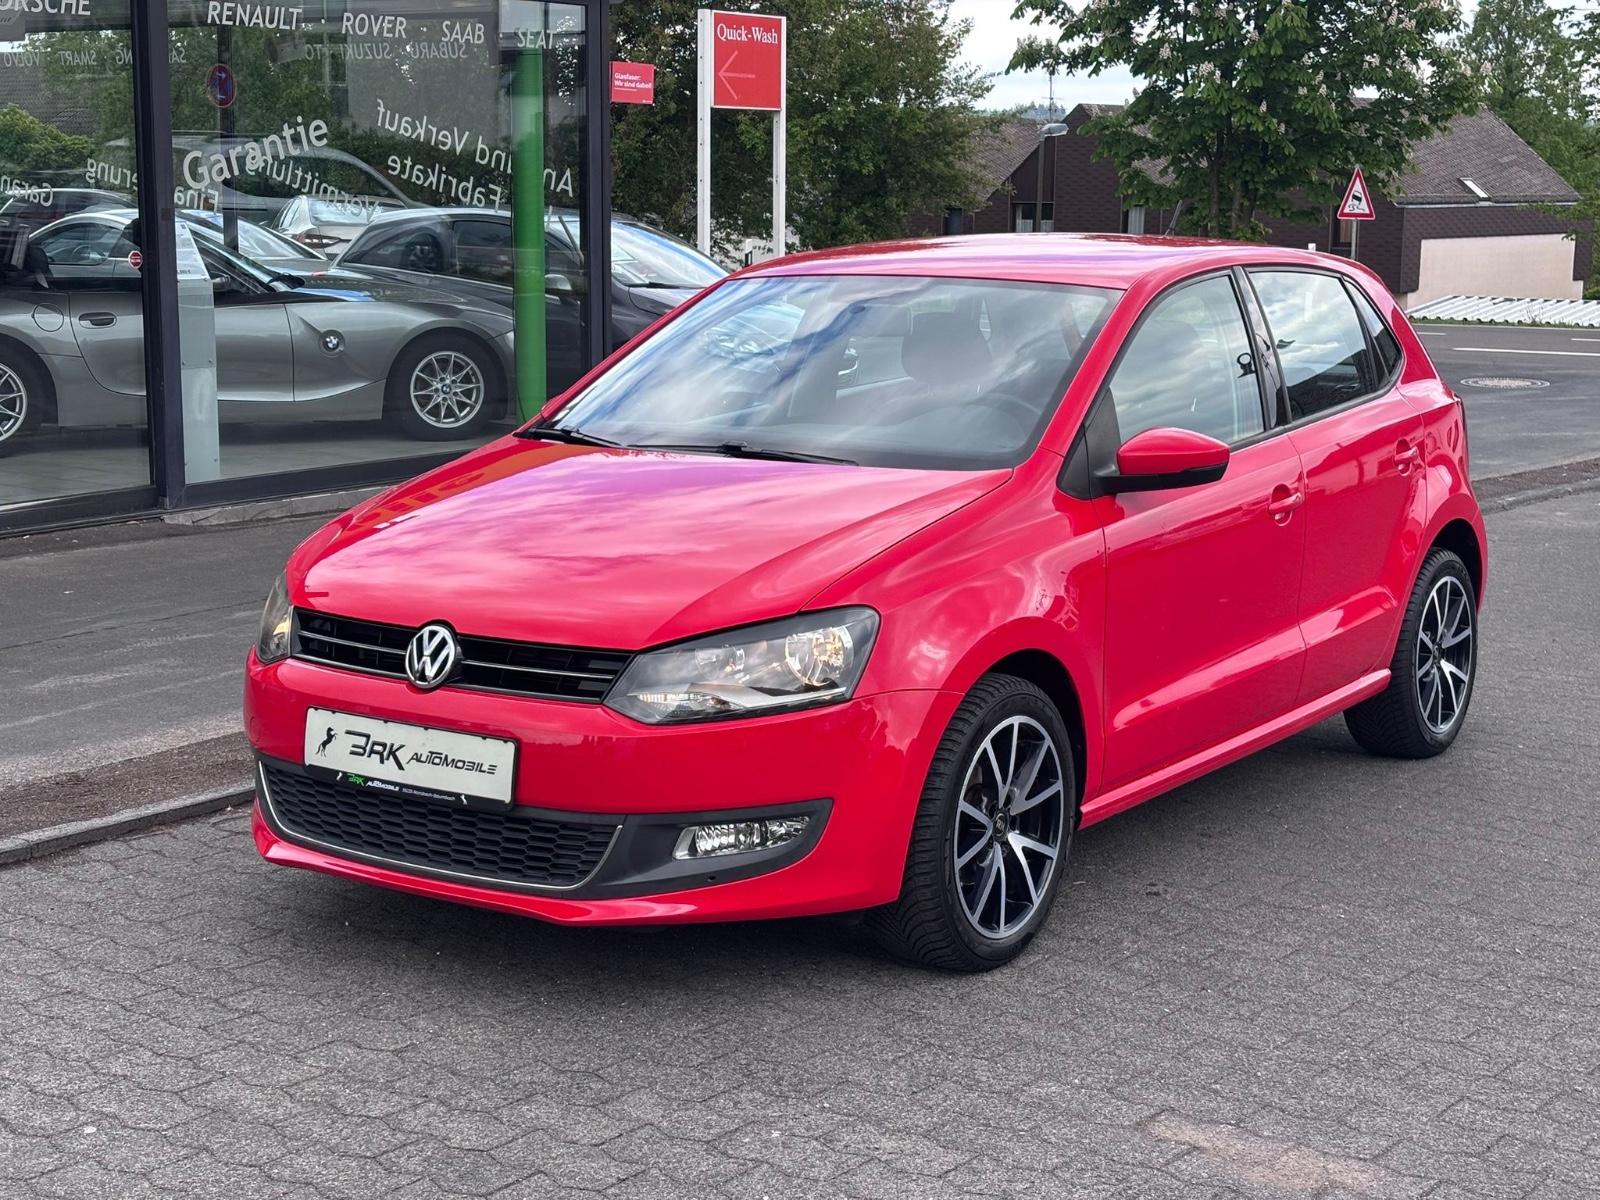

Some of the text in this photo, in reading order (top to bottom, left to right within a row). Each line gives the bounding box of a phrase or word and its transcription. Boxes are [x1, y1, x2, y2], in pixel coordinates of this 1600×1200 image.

[207, 1, 303, 30] RENAULT
[341, 12, 407, 38] ROVER
[441, 20, 485, 44] SAAB
[517, 29, 557, 49] SEAT
[717, 23, 778, 45] Quick-Wash
[182, 115, 328, 190] Garantie
[406, 750, 498, 776] AUTOMOBILE
